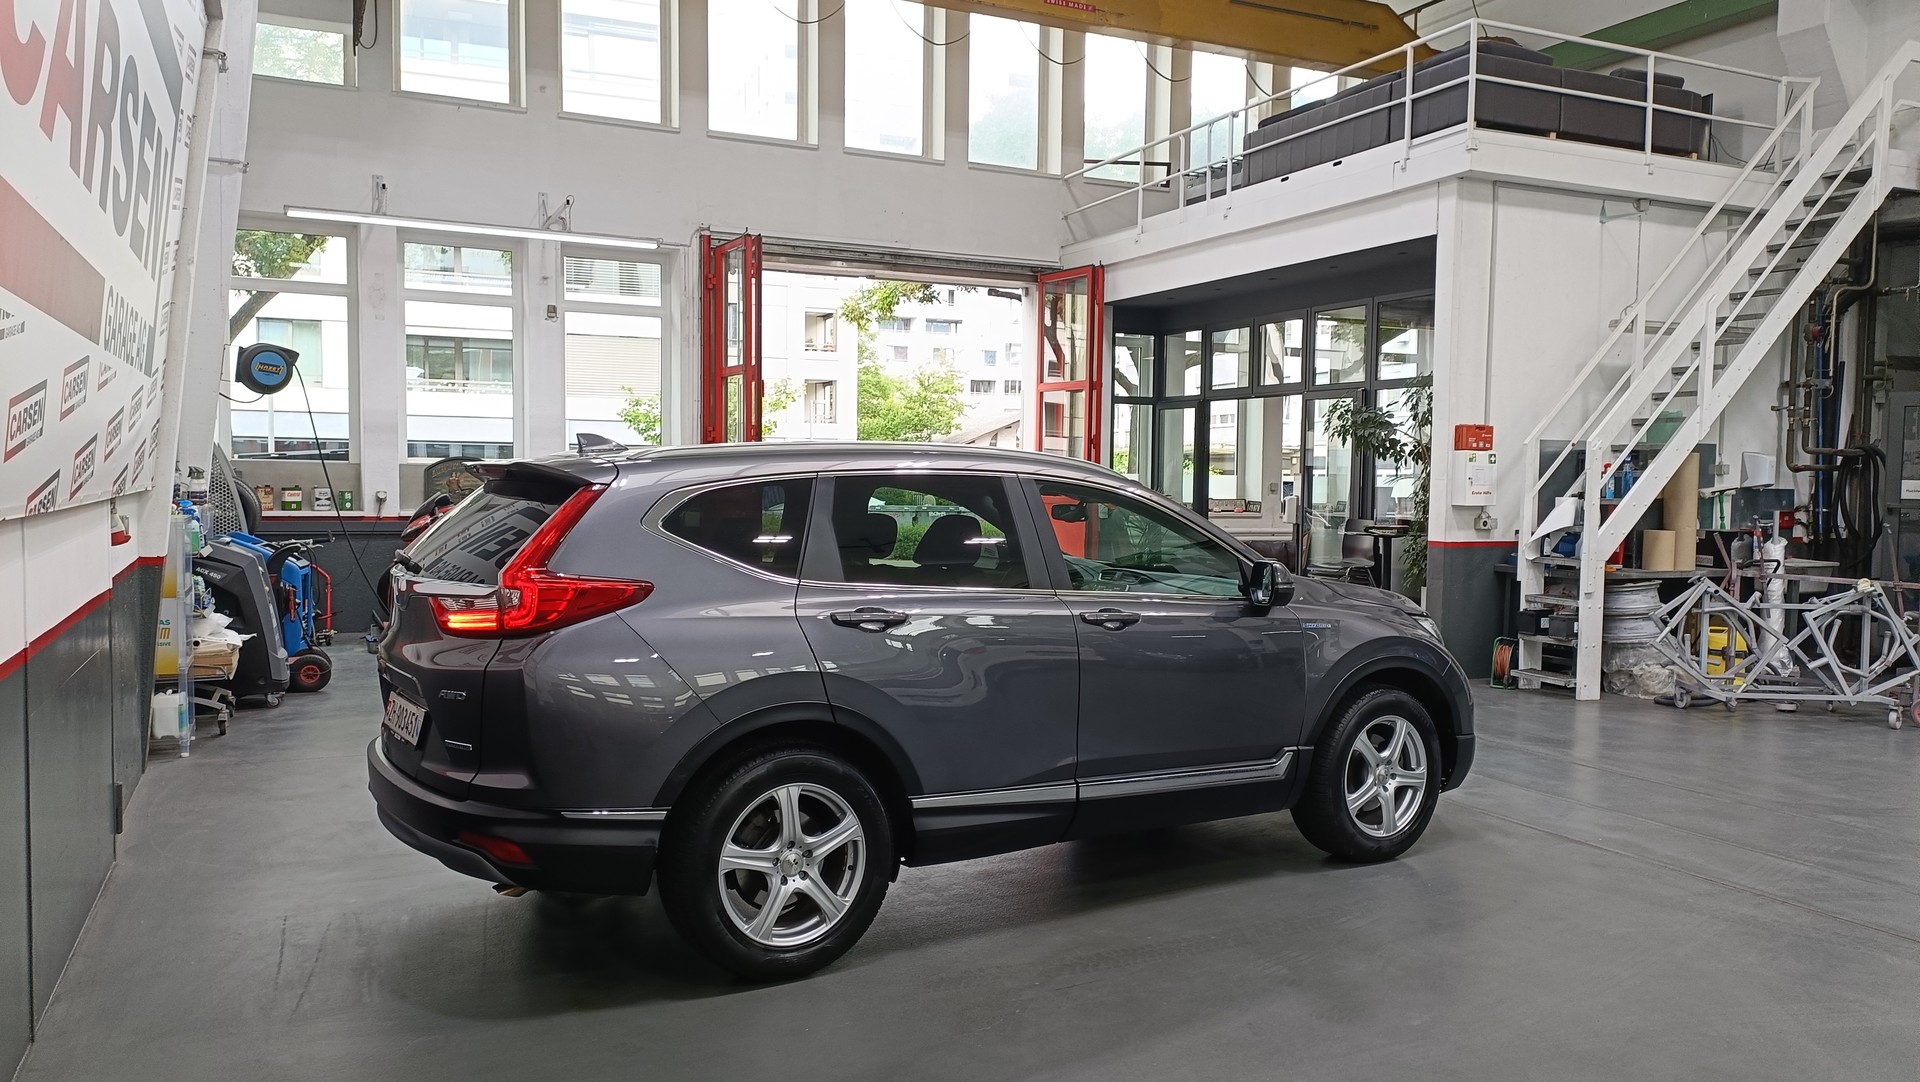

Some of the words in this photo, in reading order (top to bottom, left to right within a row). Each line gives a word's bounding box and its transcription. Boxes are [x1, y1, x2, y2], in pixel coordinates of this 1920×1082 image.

[1068, 1, 1087, 10] MADE
[0, 0, 168, 283] CARSEN
[104, 285, 139, 367] GARAGE
[134, 316, 147, 373] AG
[63, 369, 87, 404] CARSEN
[10, 396, 43, 442] CARSEN
[196, 566, 210, 576] ACX
[209, 571, 222, 580] 450
